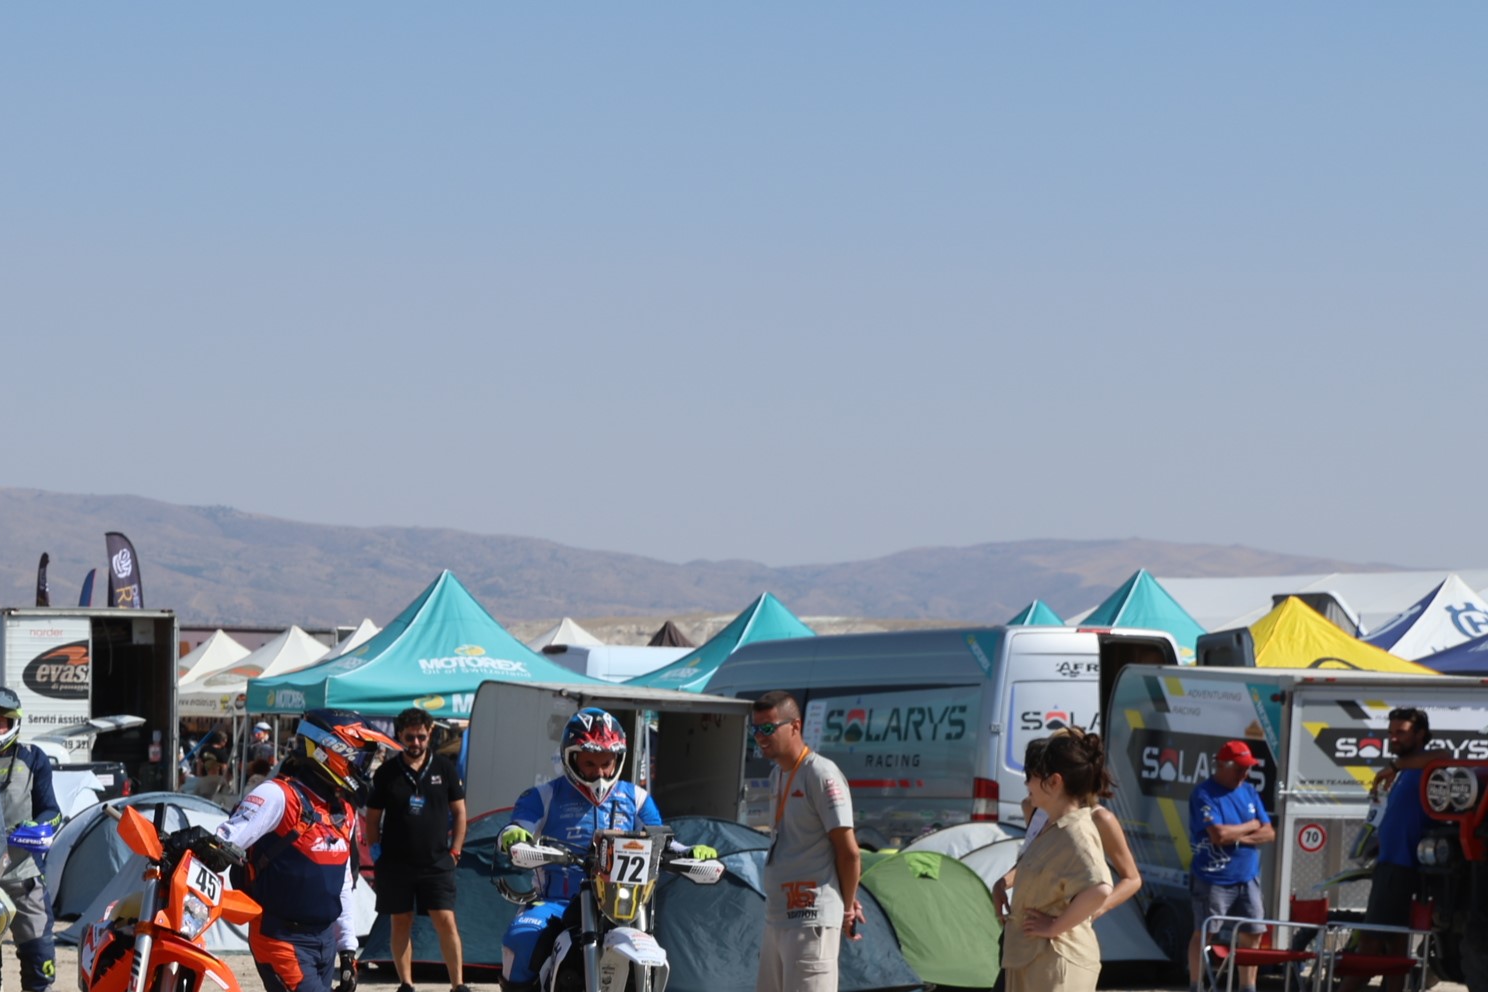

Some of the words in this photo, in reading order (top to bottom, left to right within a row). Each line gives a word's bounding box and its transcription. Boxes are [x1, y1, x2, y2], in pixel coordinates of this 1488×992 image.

[417, 656, 527, 673] MOTOREX
[462, 668, 531, 678] Switzerland
[1172, 707, 1201, 716] RACING
[28, 714, 56, 724] Servizi
[824, 706, 967, 743] SOLARYS
[865, 754, 920, 767] RACING
[1305, 831, 1319, 843] 70
[616, 855, 645, 882] 72
[195, 867, 218, 900] 45
